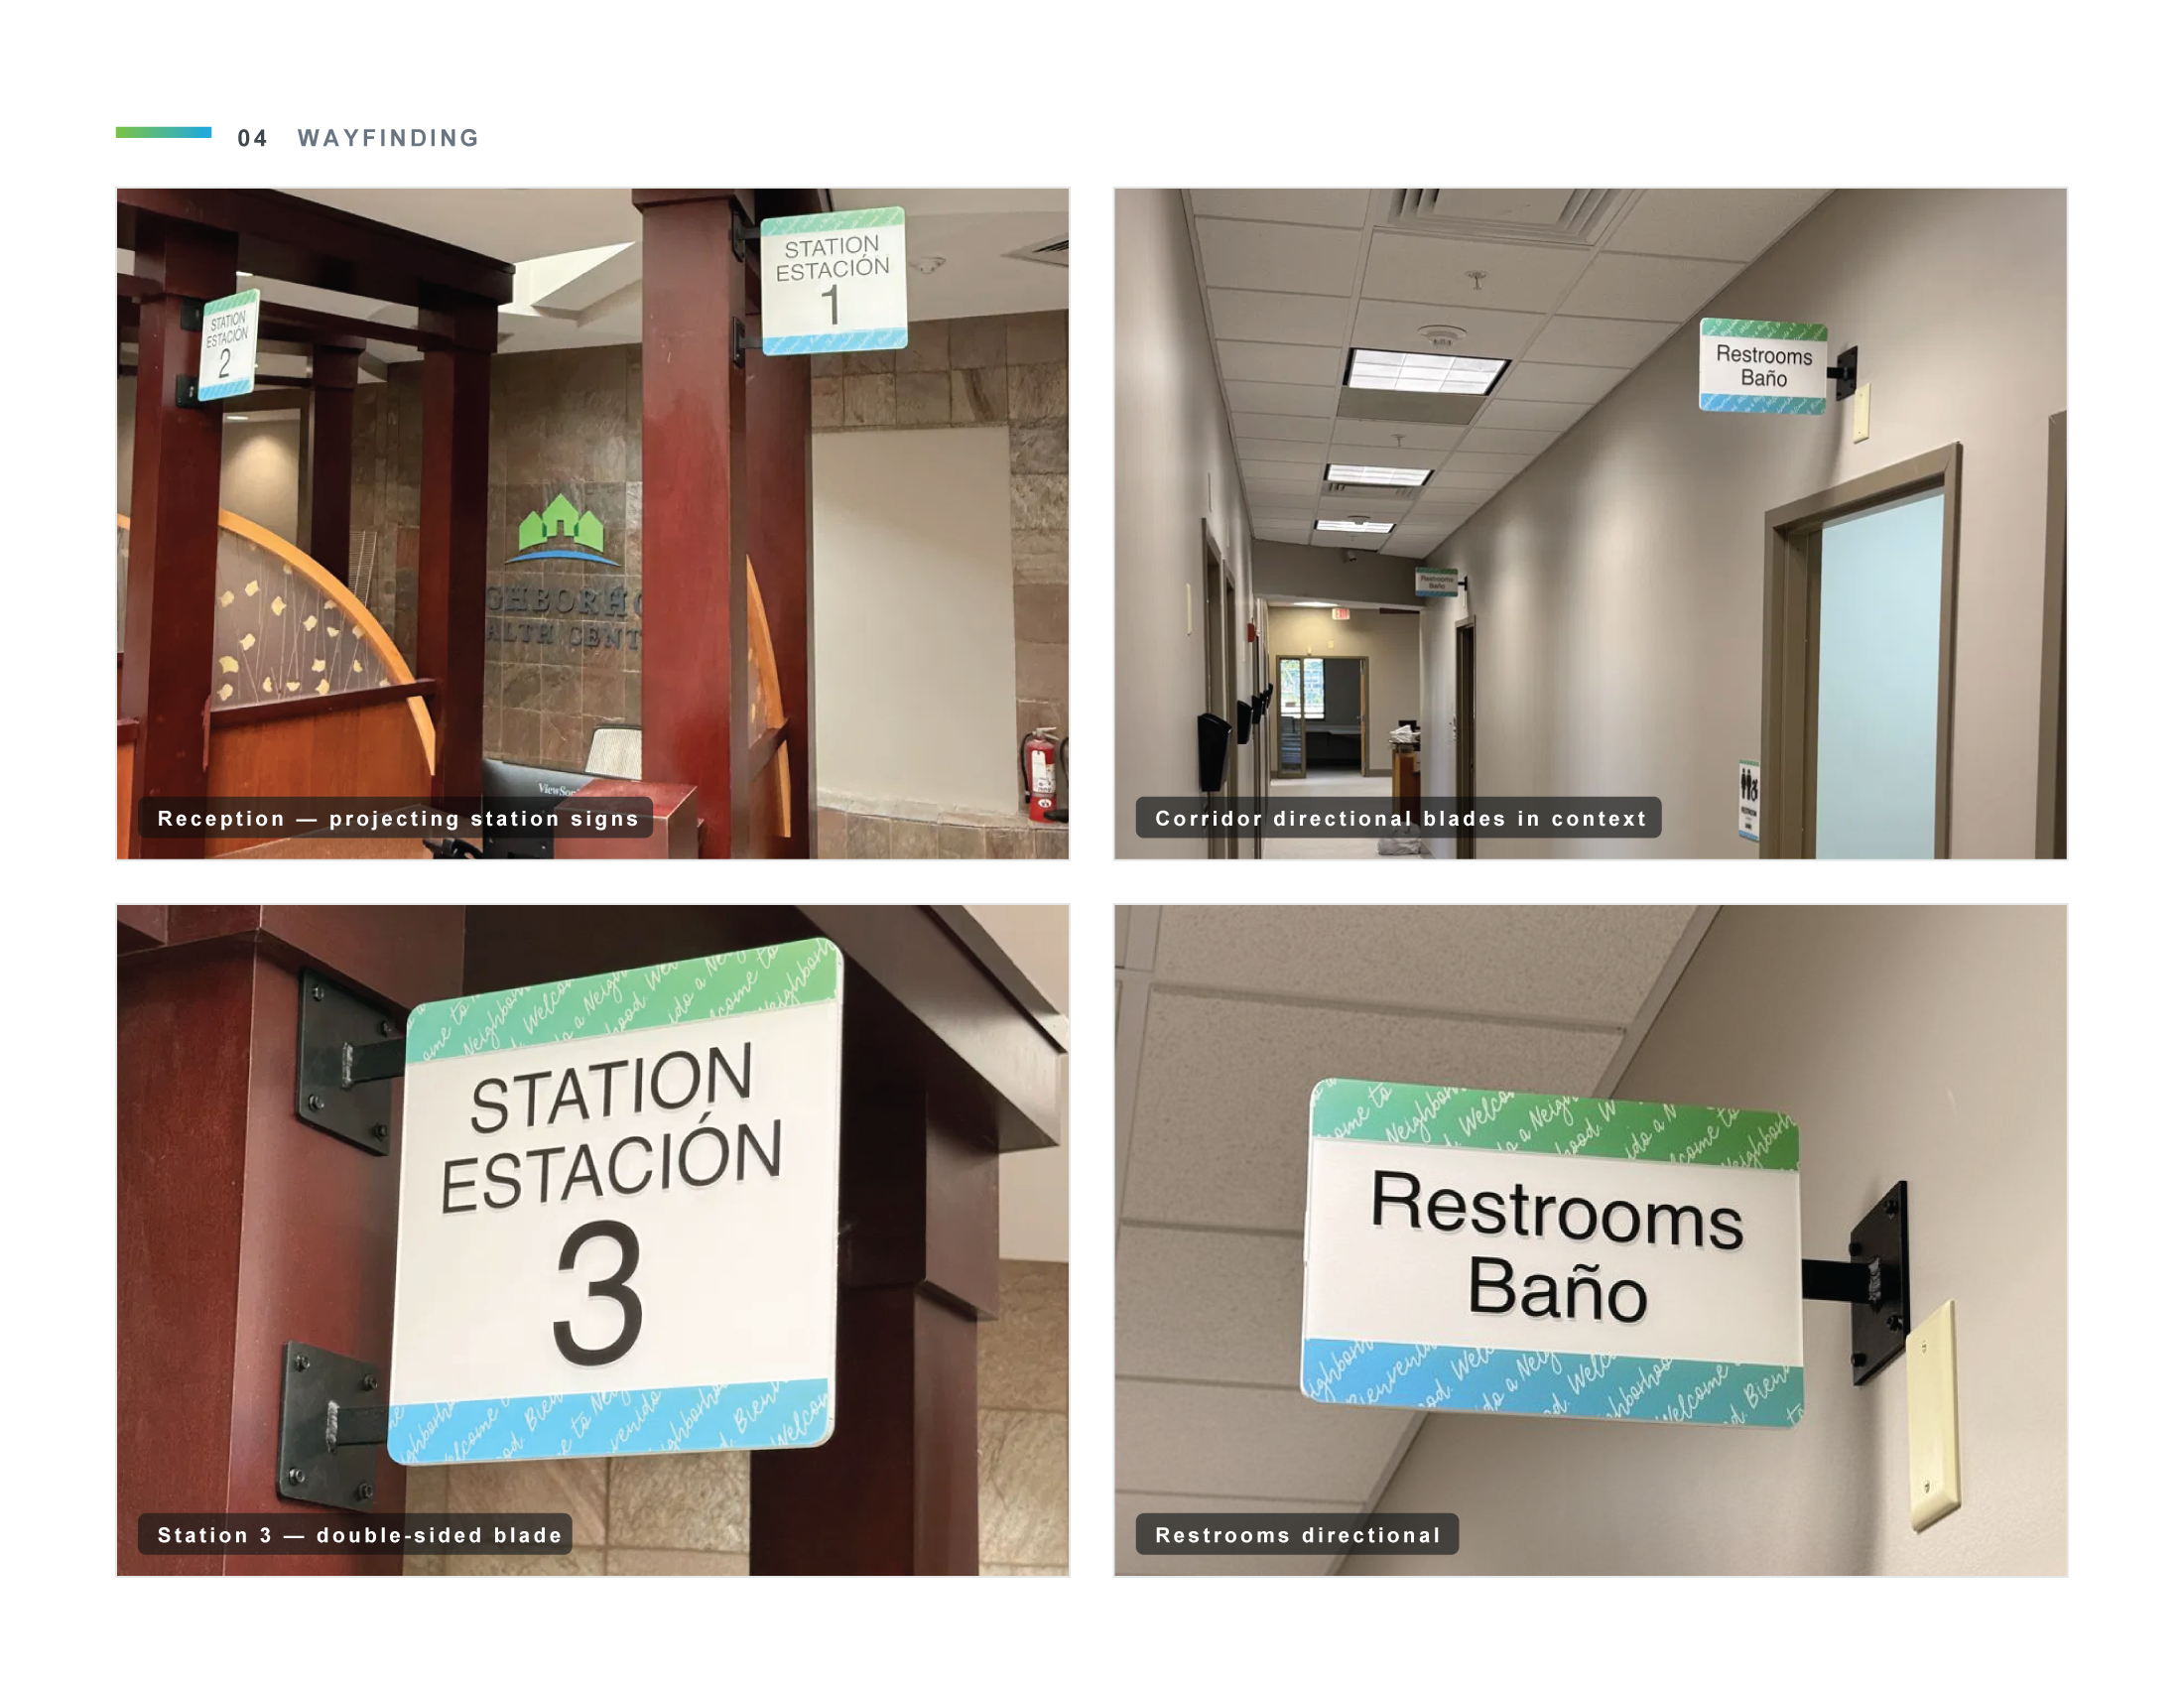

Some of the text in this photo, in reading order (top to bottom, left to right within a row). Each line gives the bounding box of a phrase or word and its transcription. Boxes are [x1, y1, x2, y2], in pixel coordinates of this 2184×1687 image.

[785, 234, 879, 259] STATION
[776, 253, 890, 282] ESTACIÓN
[821, 284, 838, 325] 1
[206, 324, 248, 349] ESTACIÓN
[210, 311, 246, 331] STATION
[218, 347, 231, 379] 2
[1717, 343, 1813, 366] Restrooms
[1741, 368, 1788, 388] Baño
[471, 1042, 752, 1134] STATION
[443, 1111, 782, 1214] ESTACIÓN
[1373, 1169, 1744, 1250] Restrooms
[553, 1220, 644, 1366] 3
[1471, 1255, 1648, 1324] Baño
